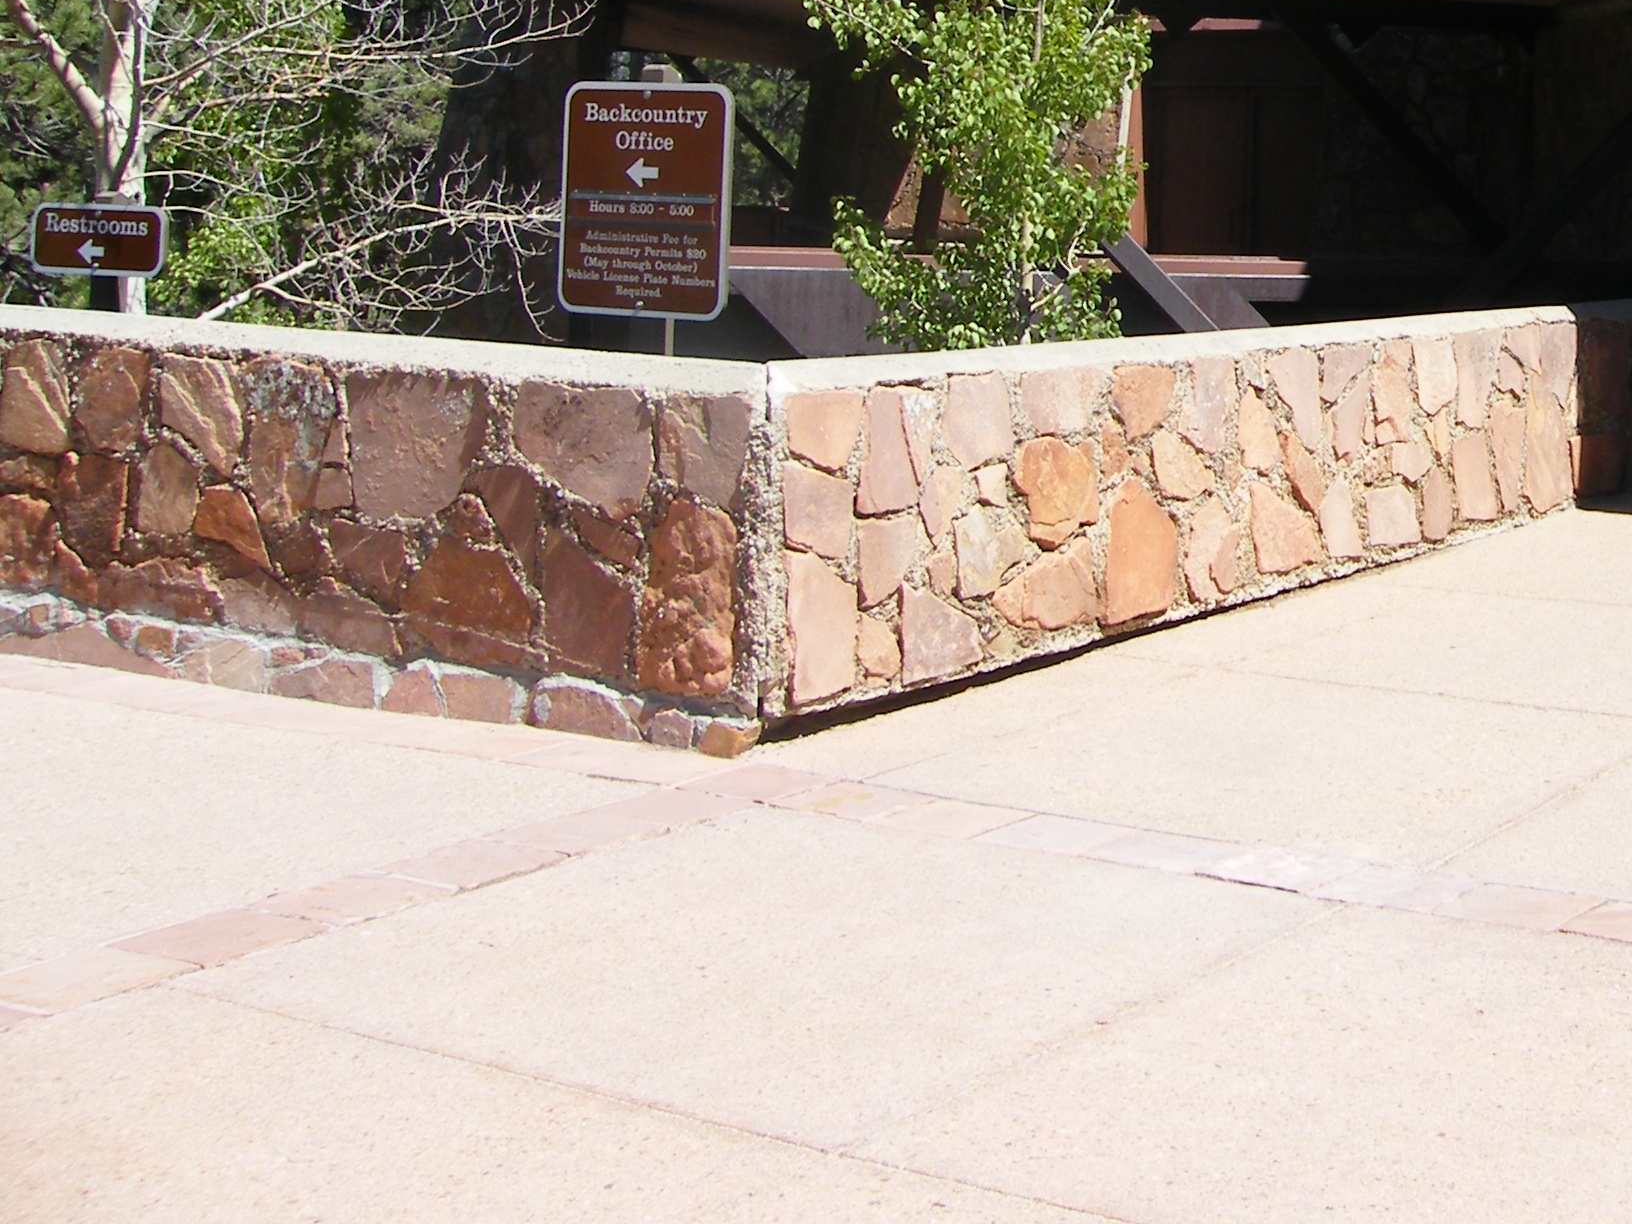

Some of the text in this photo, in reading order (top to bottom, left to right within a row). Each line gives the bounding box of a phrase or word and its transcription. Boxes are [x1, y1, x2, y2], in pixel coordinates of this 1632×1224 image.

[585, 103, 708, 129] Backcountry
[616, 131, 674, 151] Office
[589, 200, 625, 213] Hours
[630, 203, 654, 215] 8:00
[669, 205, 694, 216] 5:00
[46, 212, 149, 236] Restrooms
[586, 230, 698, 246] Administrative Fee for
[580, 243, 641, 258] Backcountry
[644, 247, 682, 258] Permits
[584, 256, 698, 273] (May through October)
[567, 269, 716, 287] Vehicle License Plate Numbers
